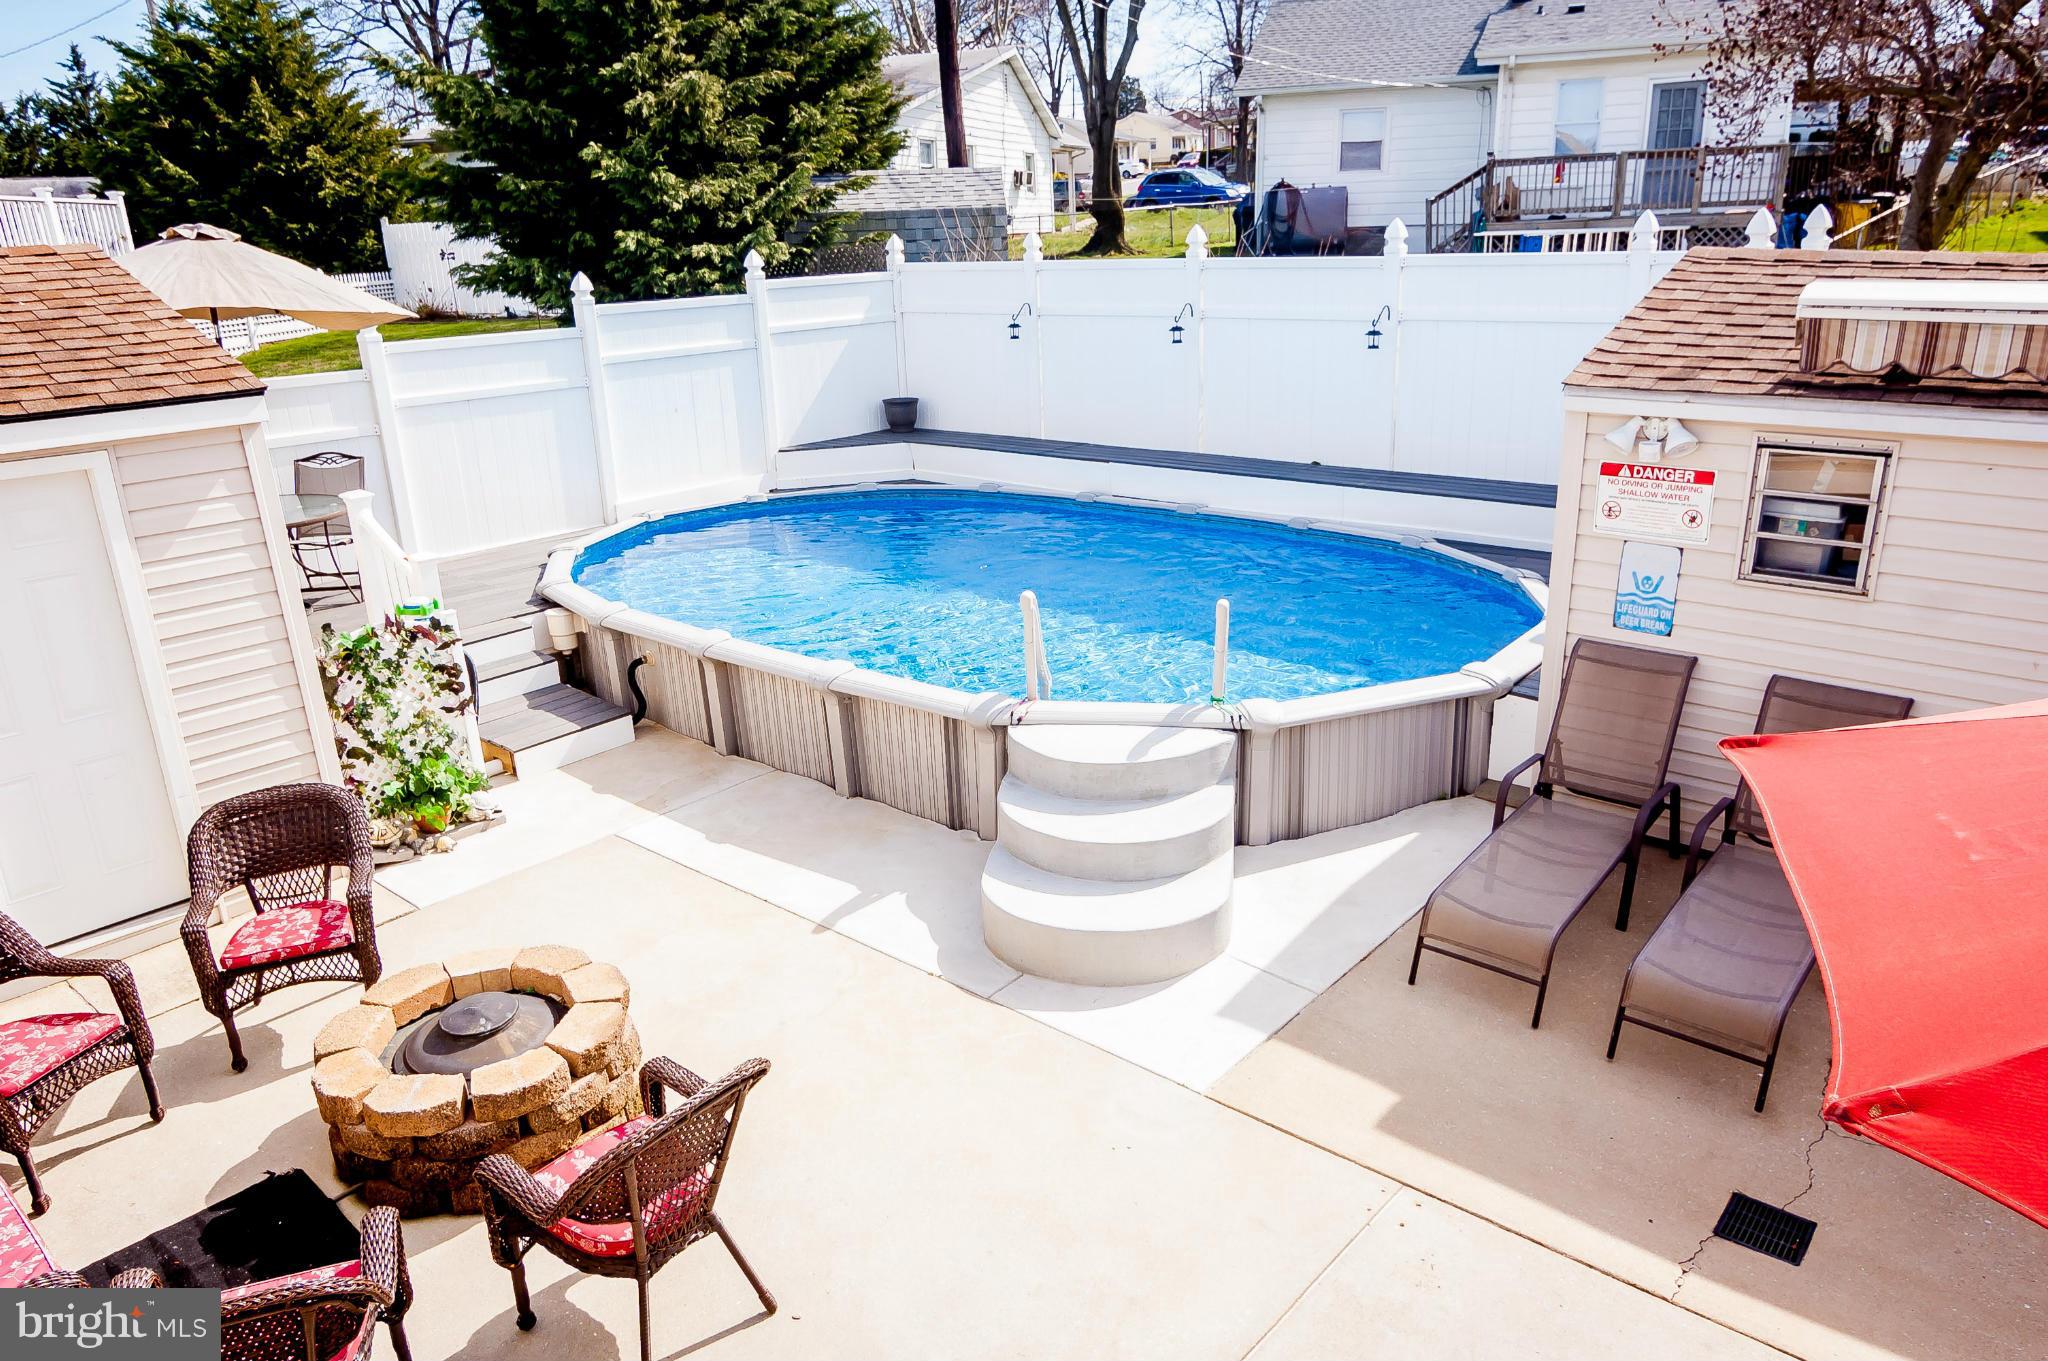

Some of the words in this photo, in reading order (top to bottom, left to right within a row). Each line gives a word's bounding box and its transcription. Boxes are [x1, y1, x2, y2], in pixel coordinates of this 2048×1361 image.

[1633, 465, 1695, 483] DANGER
[1608, 478, 1620, 486] NO
[1621, 479, 1649, 488] DIVING
[1651, 482, 1663, 490] OR
[1665, 483, 1703, 494] JUMPING
[1618, 488, 1659, 499] SHALLOW
[1661, 492, 1690, 502] WATER
[1617, 603, 1659, 618] LIFEGUARD
[1660, 610, 1672, 619] ON
[1620, 615, 1639, 627] BEER
[1640, 619, 1665, 631] BREAK
